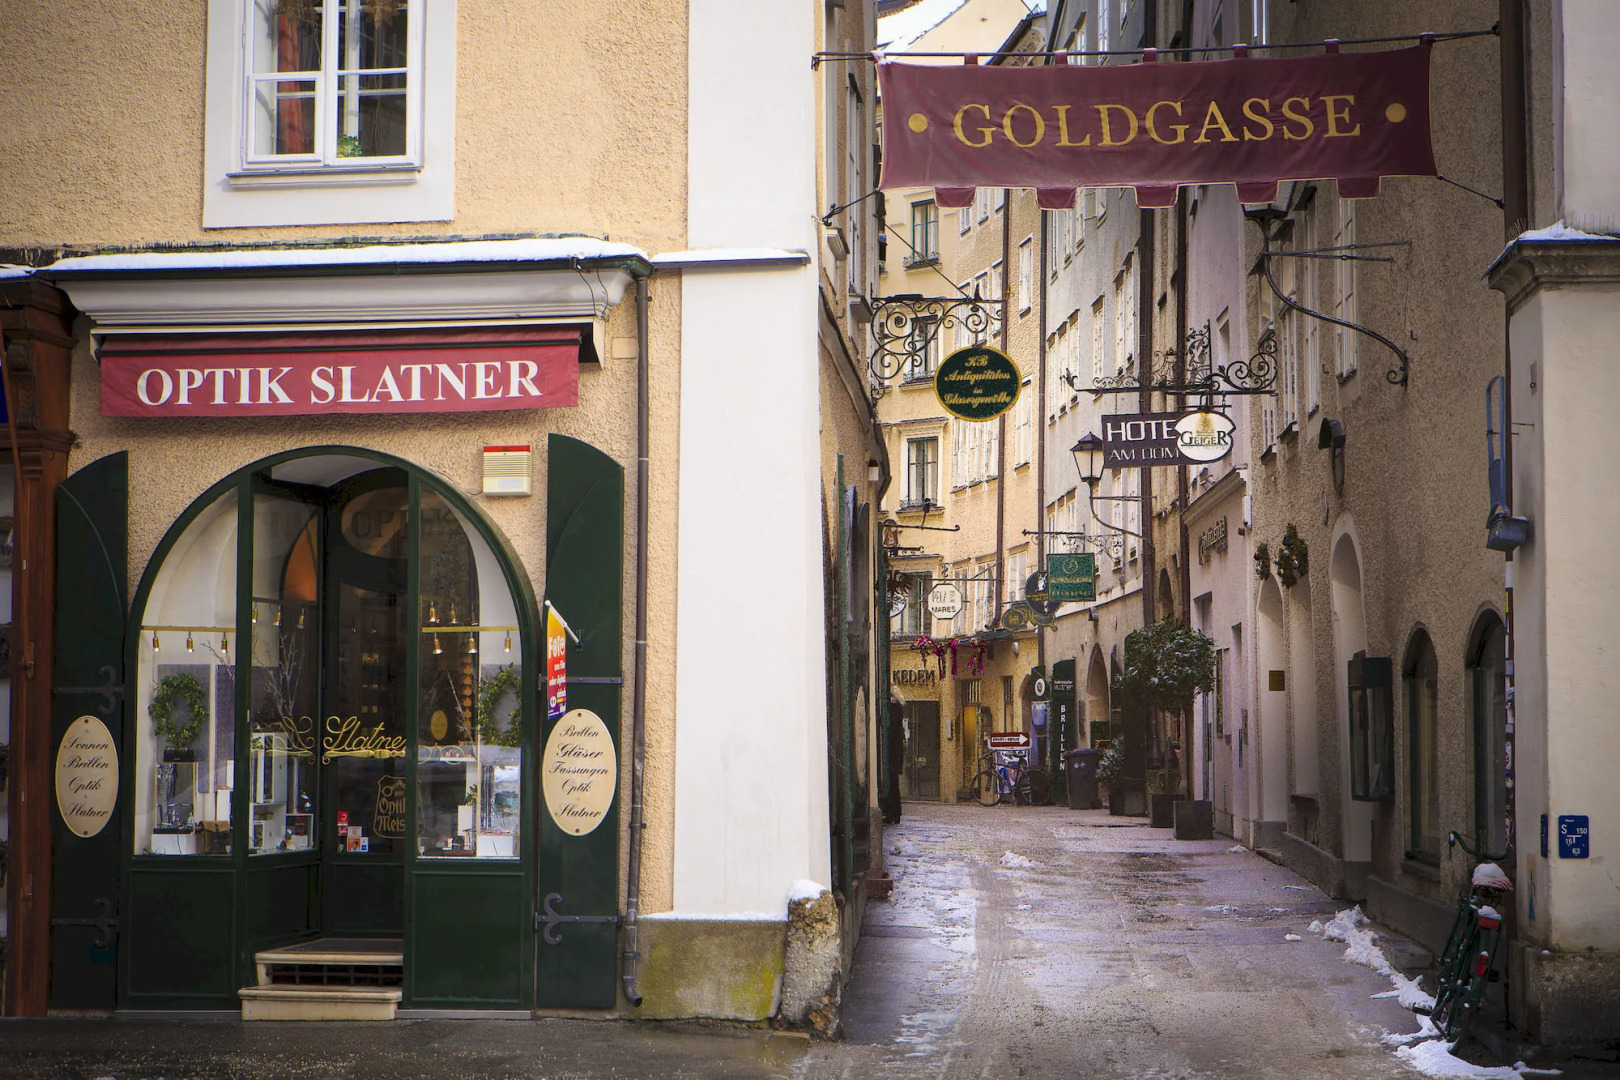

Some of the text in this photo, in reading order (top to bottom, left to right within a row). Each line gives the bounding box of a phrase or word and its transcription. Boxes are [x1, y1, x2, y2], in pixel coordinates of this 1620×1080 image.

[953, 94, 1362, 148] GOLDGASSE
[136, 359, 543, 407] OPTIK SLATNER
[1106, 419, 1177, 442] HOTE
[1108, 447, 1179, 461] AM DOM
[323, 715, 407, 752] Slatne
[559, 725, 599, 738] Brillen
[63, 736, 109, 750] Sonnen
[556, 743, 604, 758] Gläser
[63, 755, 110, 769] Brillen
[548, 761, 609, 778] Fassungen
[68, 776, 104, 794] Optik
[561, 778, 593, 796] Optik
[64, 803, 109, 818] Slatner
[555, 803, 602, 818] Slatner
[1560, 823, 1588, 835] S 150
